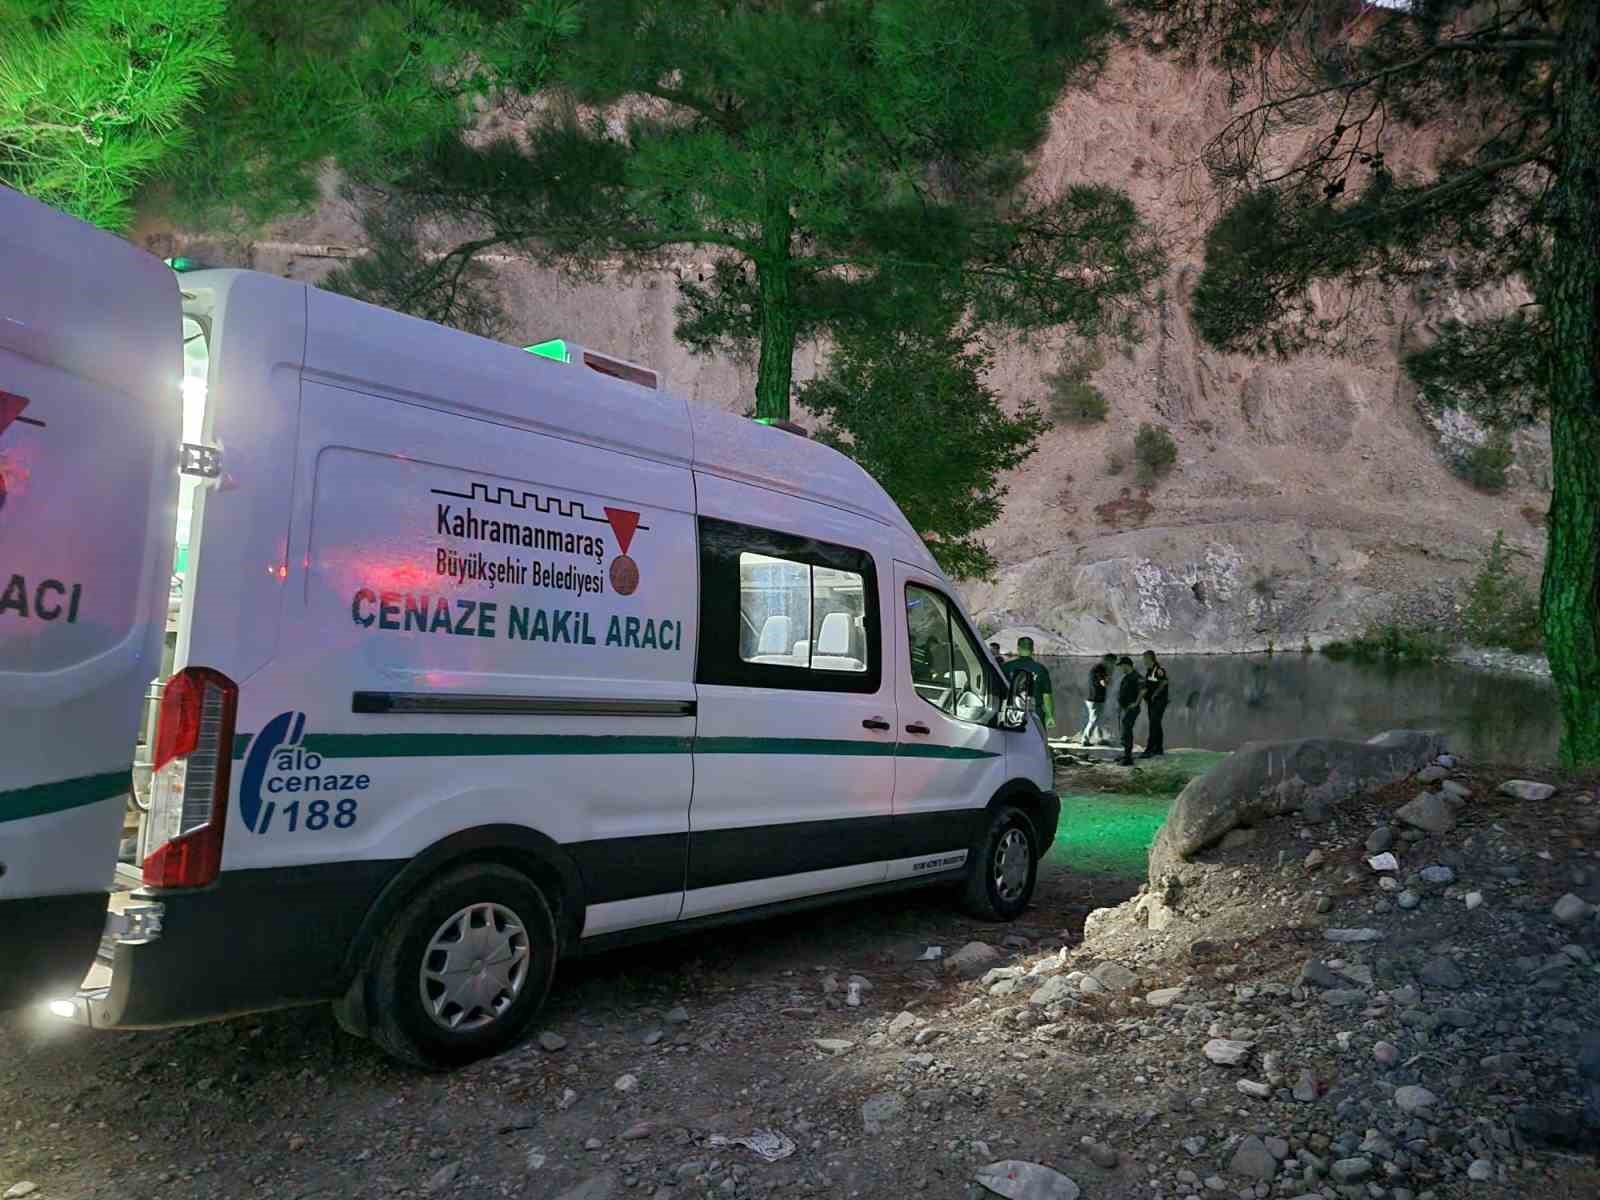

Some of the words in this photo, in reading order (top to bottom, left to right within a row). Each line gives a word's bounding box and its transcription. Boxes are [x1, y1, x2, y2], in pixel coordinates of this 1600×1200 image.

[437, 503, 605, 565] Kahramanmaraş
[436, 547, 528, 589] Büyükşehir
[532, 560, 604, 598] Belediyesi
[0, 573, 82, 624] ACI
[605, 614, 682, 651] ARACI
[276, 749, 322, 771] alo
[267, 773, 370, 793] cenaze
[282, 798, 357, 832] 188
